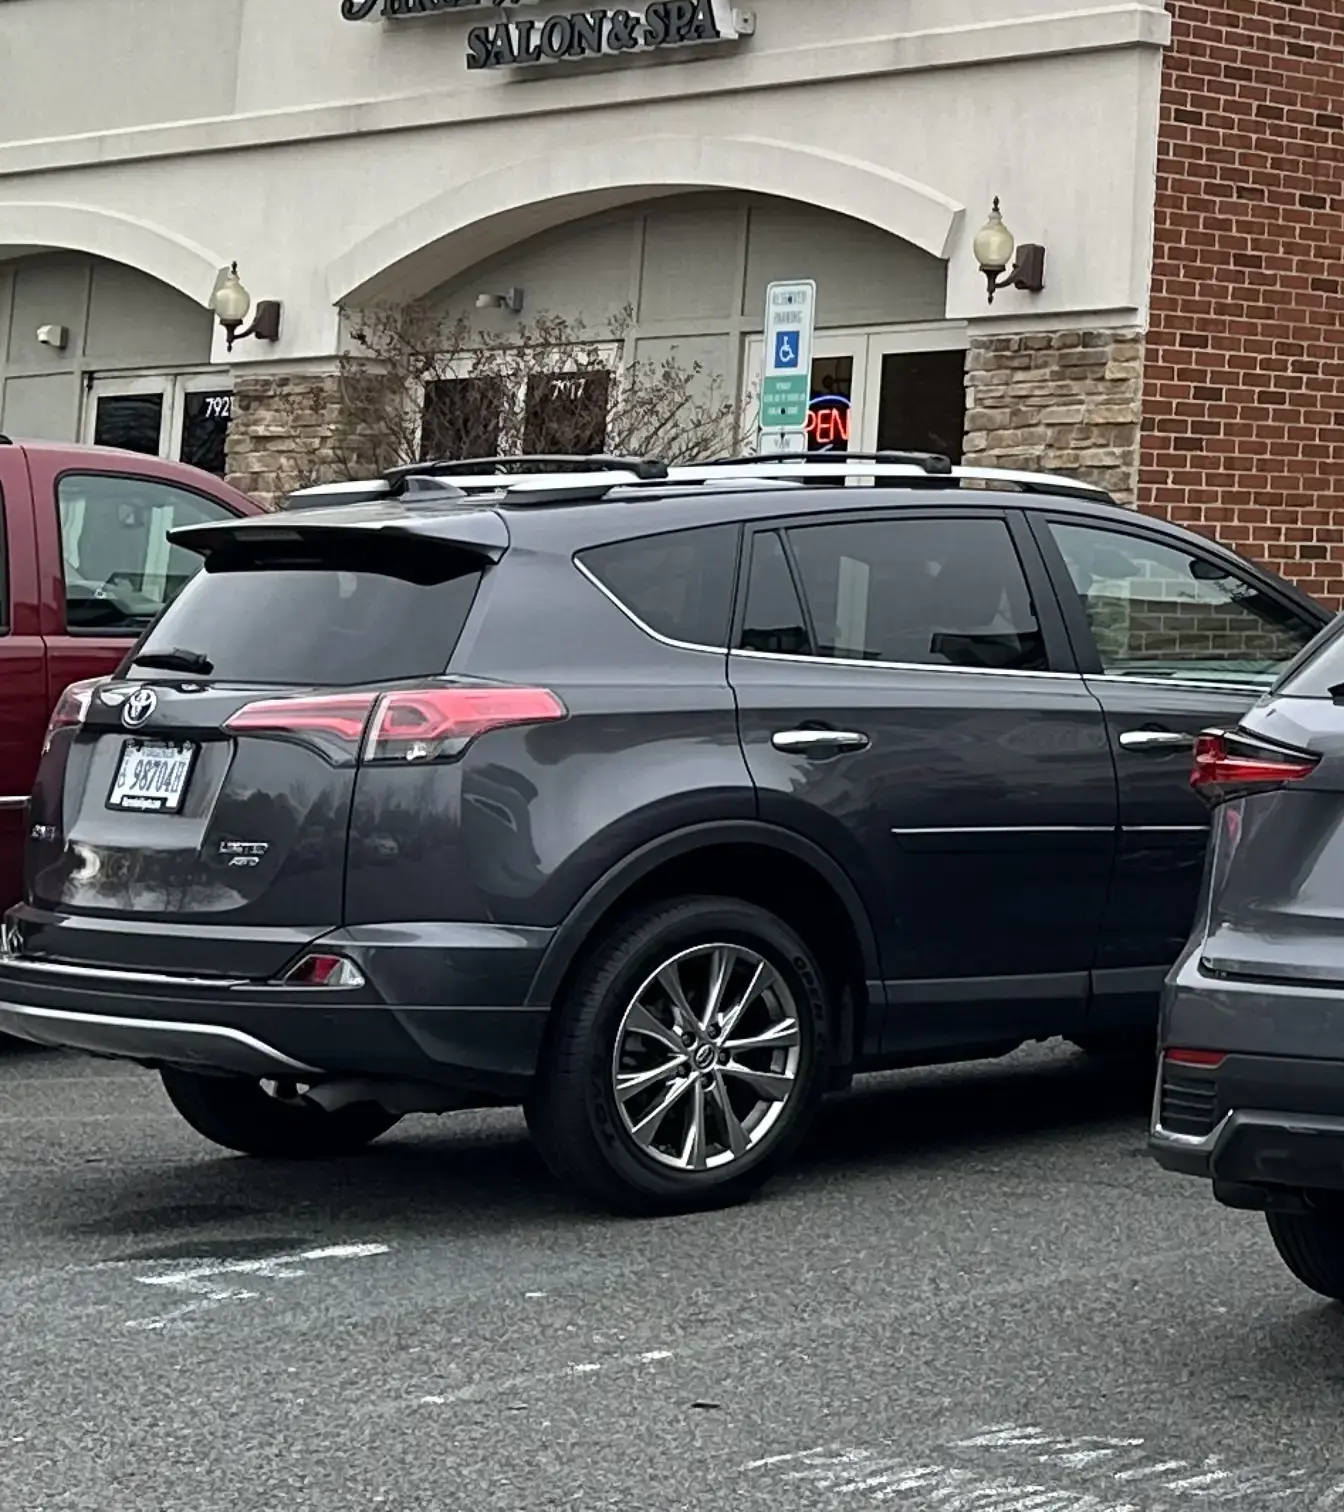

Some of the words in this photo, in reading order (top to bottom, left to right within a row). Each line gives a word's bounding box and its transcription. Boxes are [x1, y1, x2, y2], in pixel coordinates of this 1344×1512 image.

[467, 9, 603, 70] SALON
[606, 10, 636, 51] &
[805, 407, 851, 443] PEN
